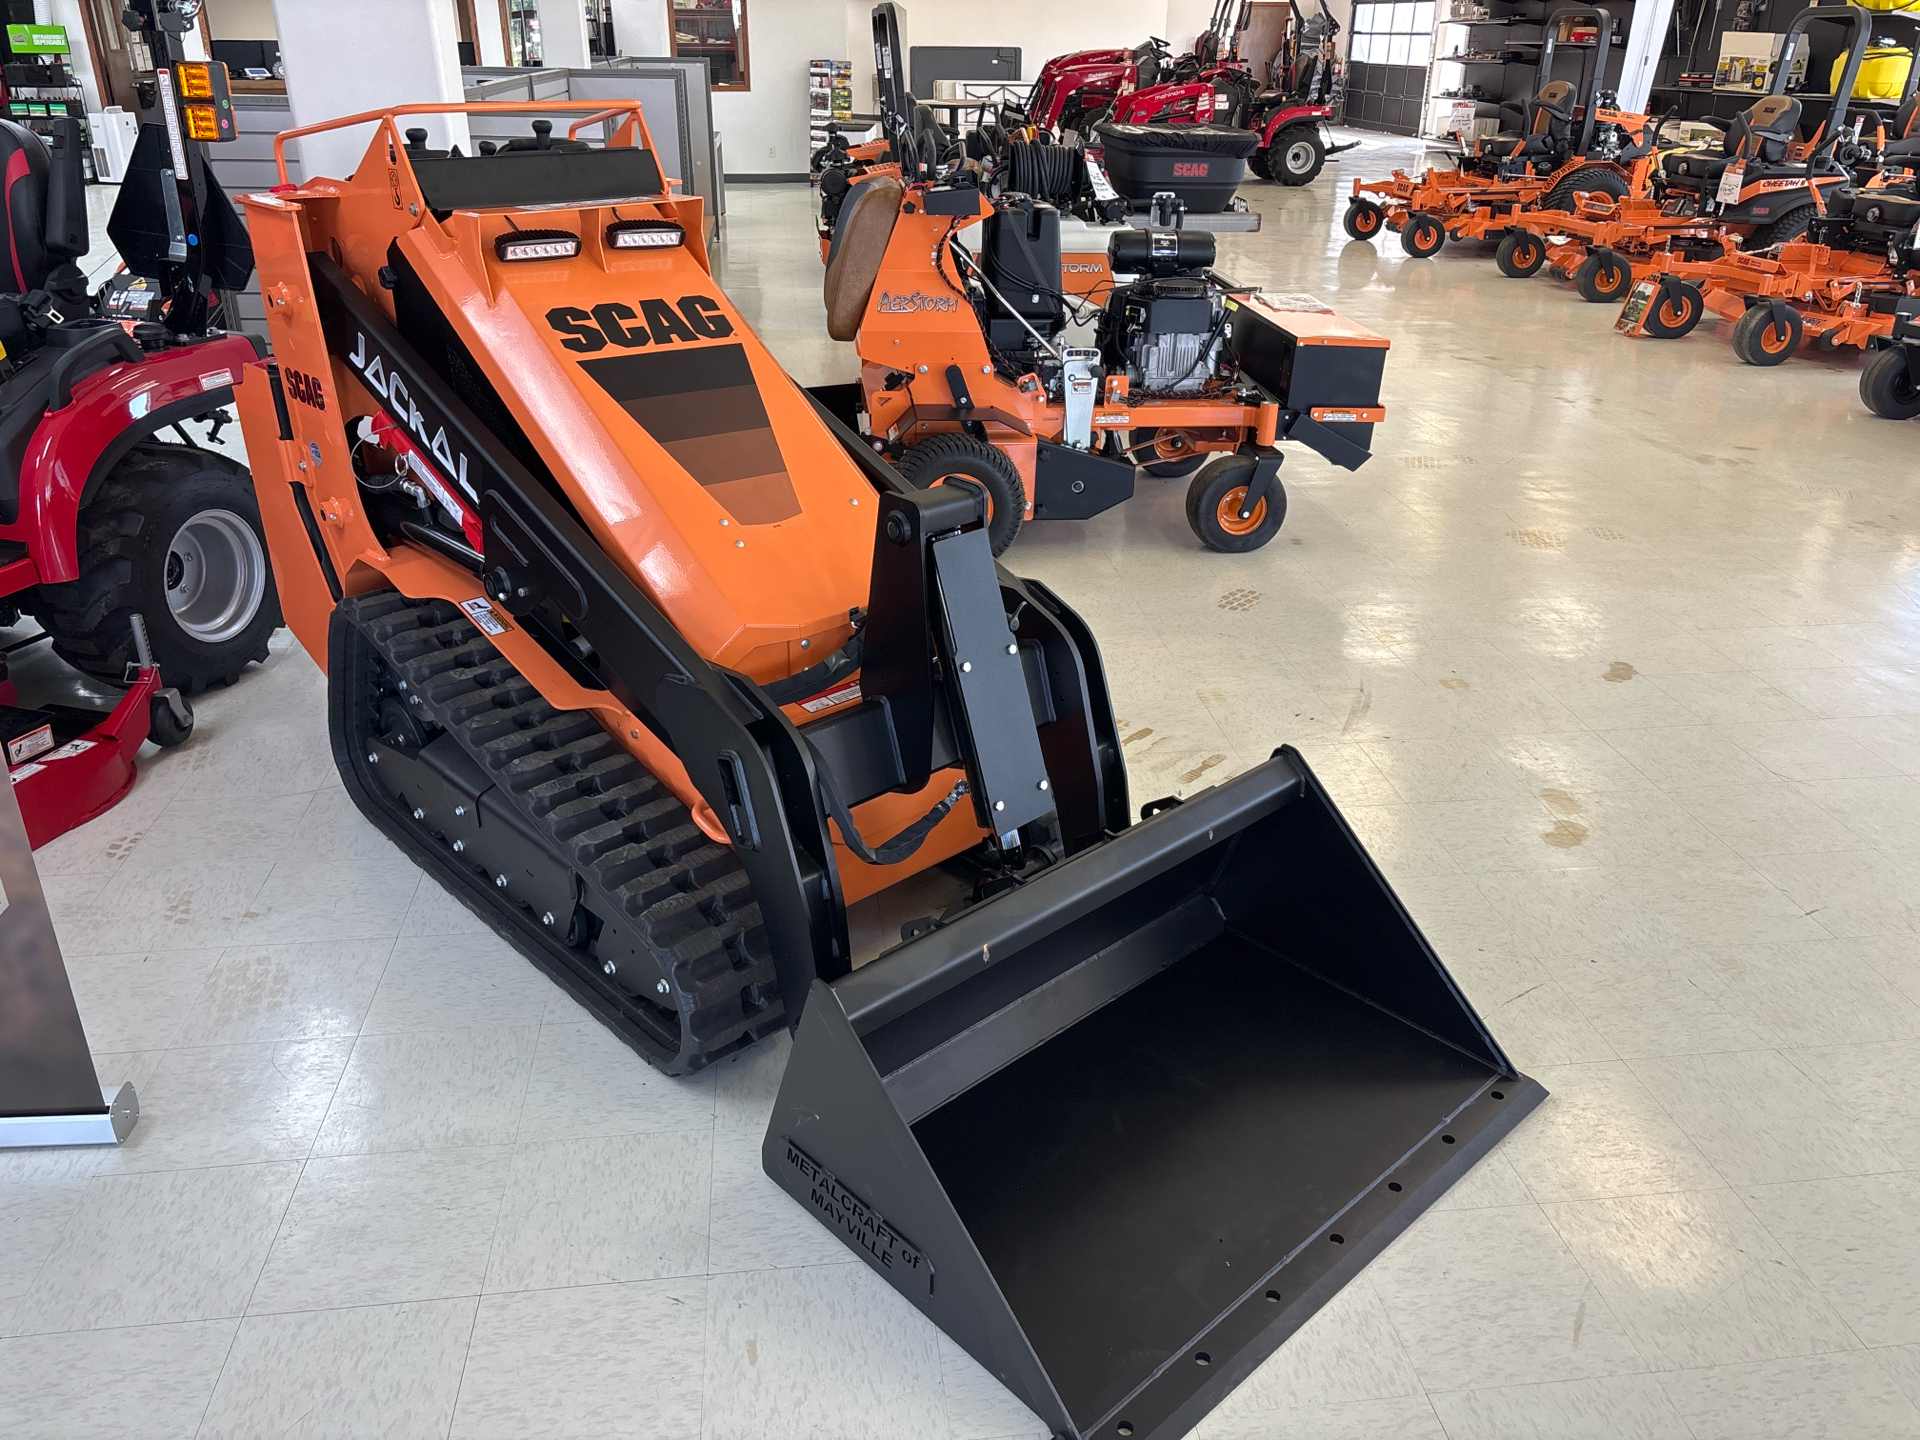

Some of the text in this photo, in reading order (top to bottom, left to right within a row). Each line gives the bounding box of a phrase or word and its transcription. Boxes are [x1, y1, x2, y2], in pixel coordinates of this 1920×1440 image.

[1599, 109, 1617, 118] SCAG
[1173, 163, 1208, 176] SCAG
[1763, 179, 1800, 188] CHEETAH
[1061, 263, 1103, 273] TORM
[1737, 256, 1750, 265] SCAG
[544, 295, 735, 353] SCAG
[285, 366, 326, 411] SCAG
[349, 331, 480, 505] JACKAL
[786, 1147, 922, 1269] METALCRAFT of
[810, 1187, 893, 1270] MAYVILLE
